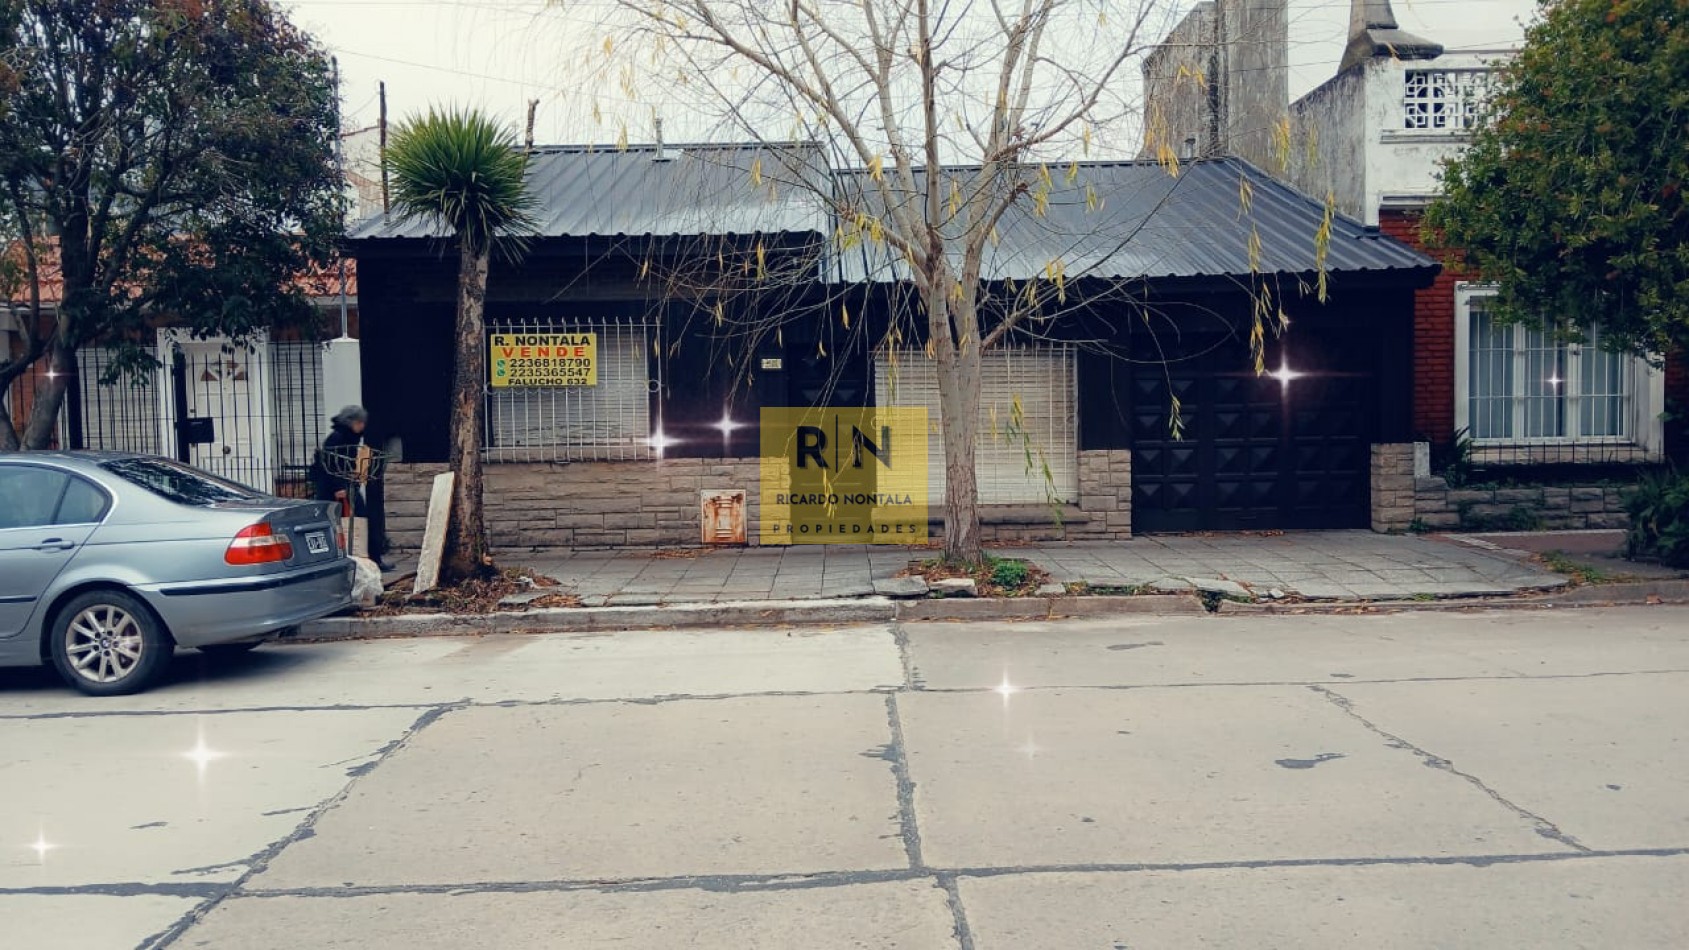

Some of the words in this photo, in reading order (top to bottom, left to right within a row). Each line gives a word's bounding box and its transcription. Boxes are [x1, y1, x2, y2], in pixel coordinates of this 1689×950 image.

[494, 336, 510, 346] R.
[515, 336, 591, 346] NONTALA
[502, 347, 585, 358] VENDE
[510, 359, 591, 368] 2236818790
[510, 368, 591, 377] 2235365547
